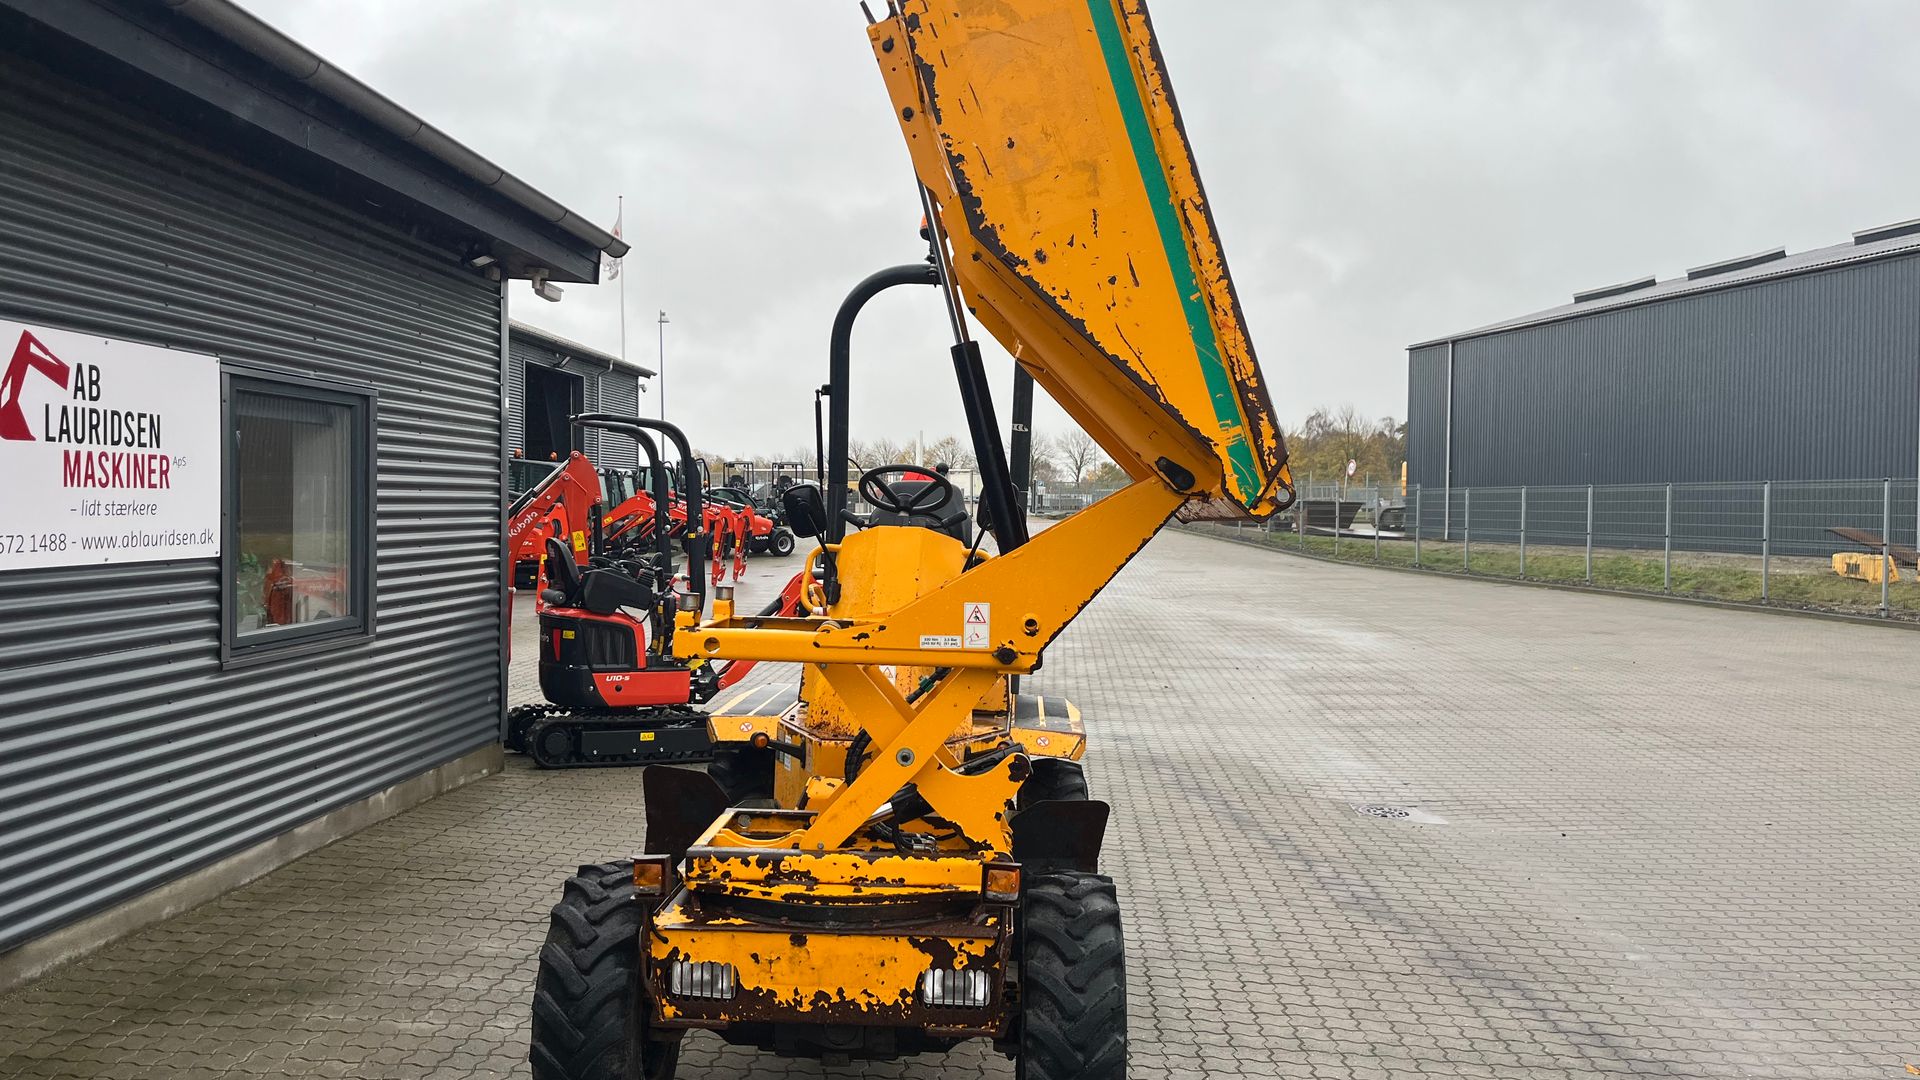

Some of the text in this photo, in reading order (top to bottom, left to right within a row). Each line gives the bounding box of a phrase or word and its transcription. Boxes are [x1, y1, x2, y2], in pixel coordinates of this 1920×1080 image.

[73, 363, 101, 402] AB
[45, 403, 161, 449] LAURIDSEN
[63, 449, 187, 489] MASKINER ApS
[81, 499, 101, 516] lidt
[104, 500, 158, 516] stærkere
[508, 511, 538, 537] Kubota
[30, 533, 67, 553] 1488
[81, 528, 214, 550] www.ablauridsen.dk
